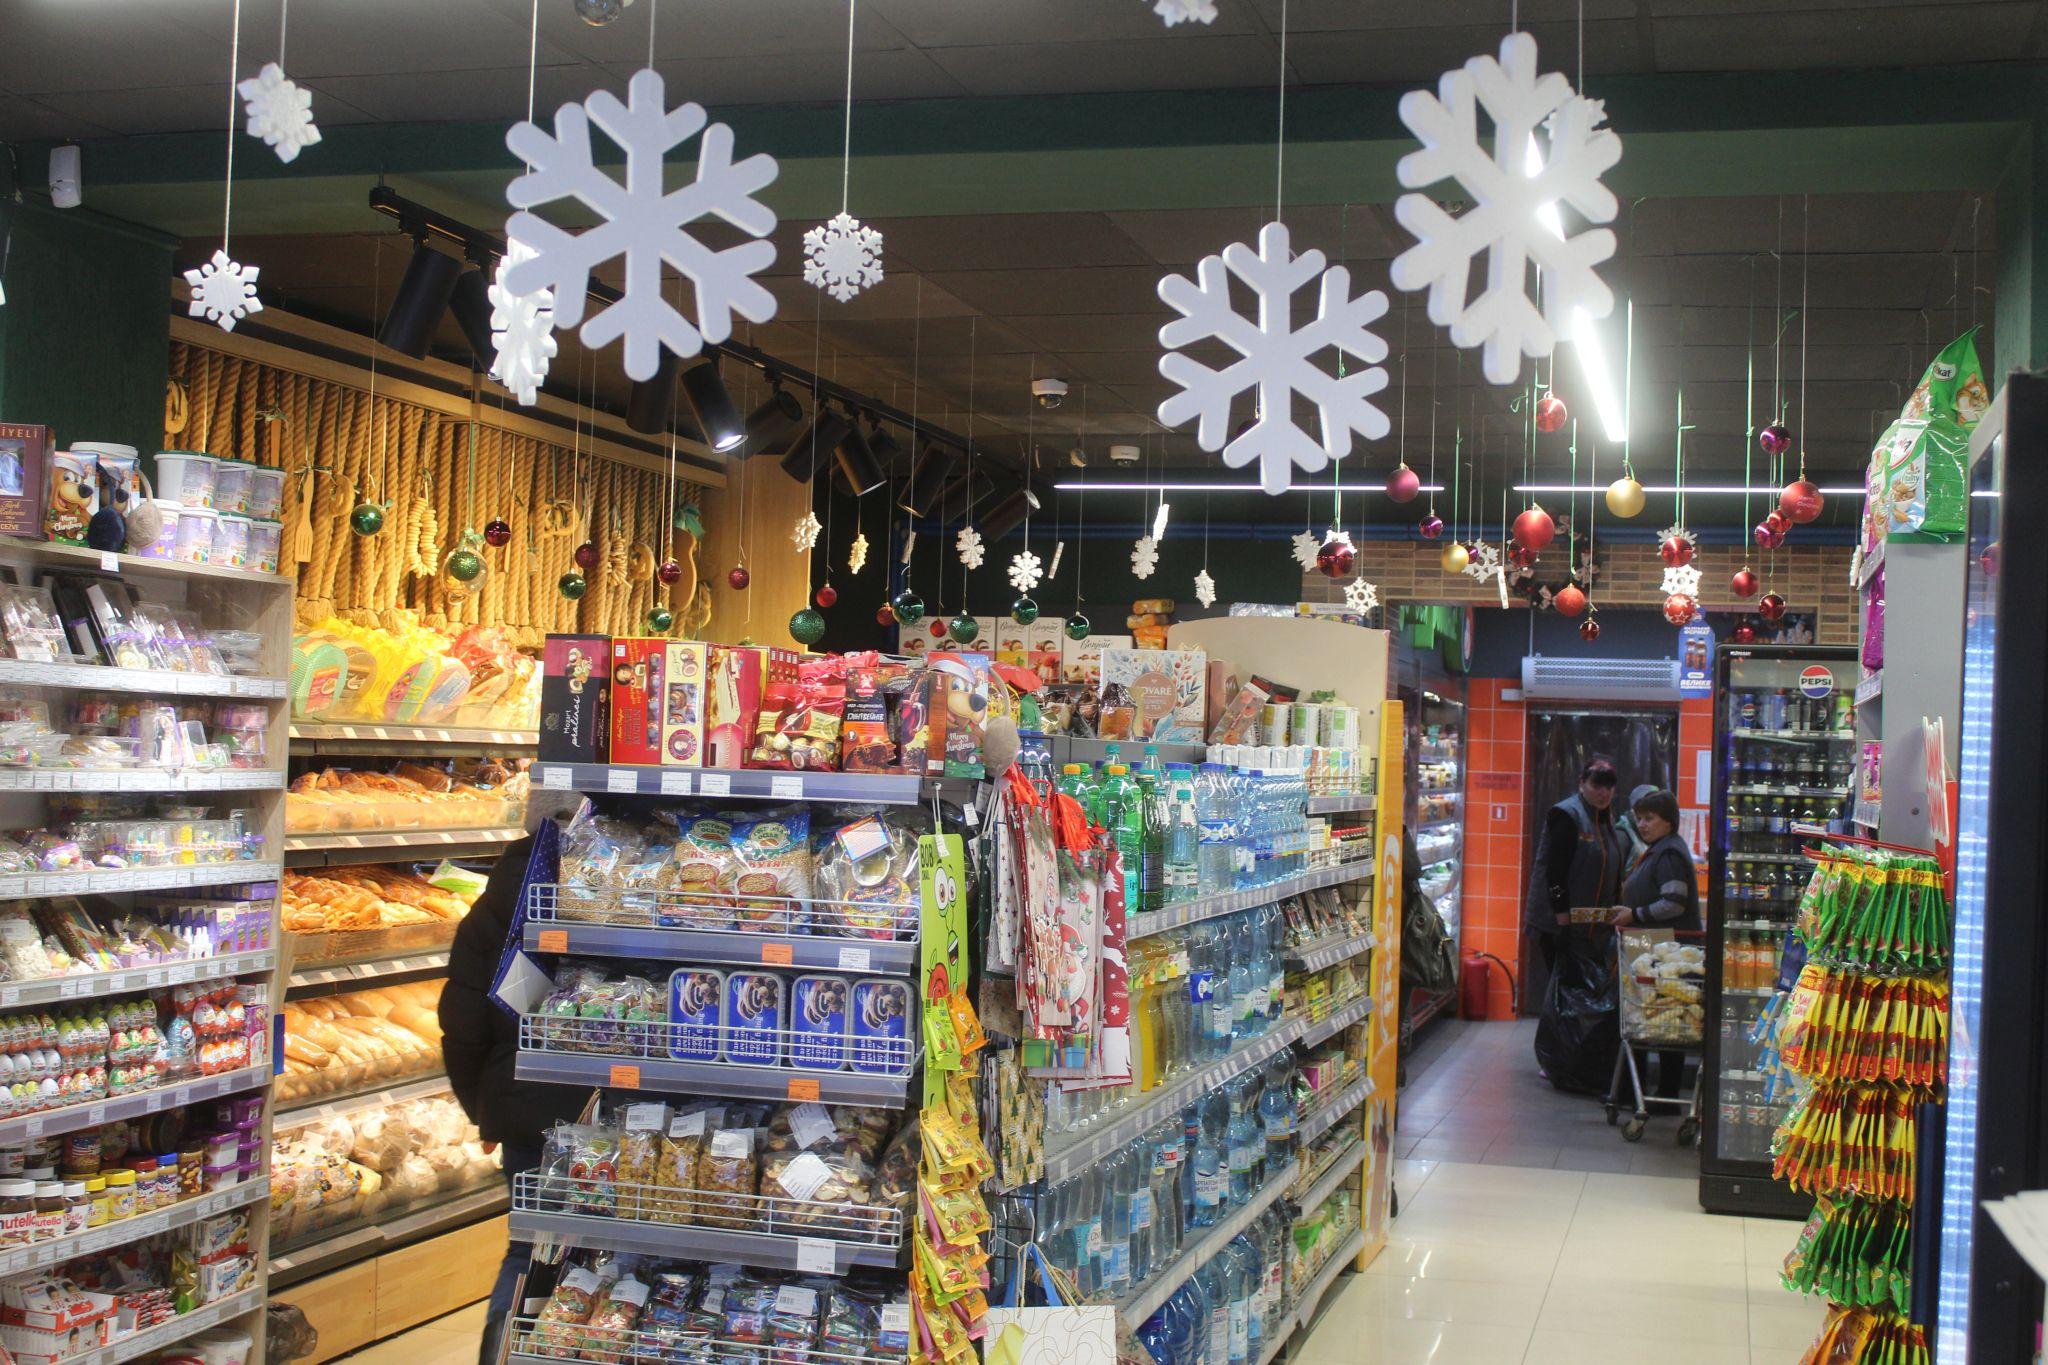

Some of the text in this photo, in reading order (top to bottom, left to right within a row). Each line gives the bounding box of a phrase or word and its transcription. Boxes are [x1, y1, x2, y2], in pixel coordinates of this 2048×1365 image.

[1801, 678, 1832, 686] PEPSI
[563, 709, 572, 734] Mozart
[571, 694, 581, 748] pralines
[920, 843, 934, 868] BOB
[37, 1217, 61, 1227] utella
